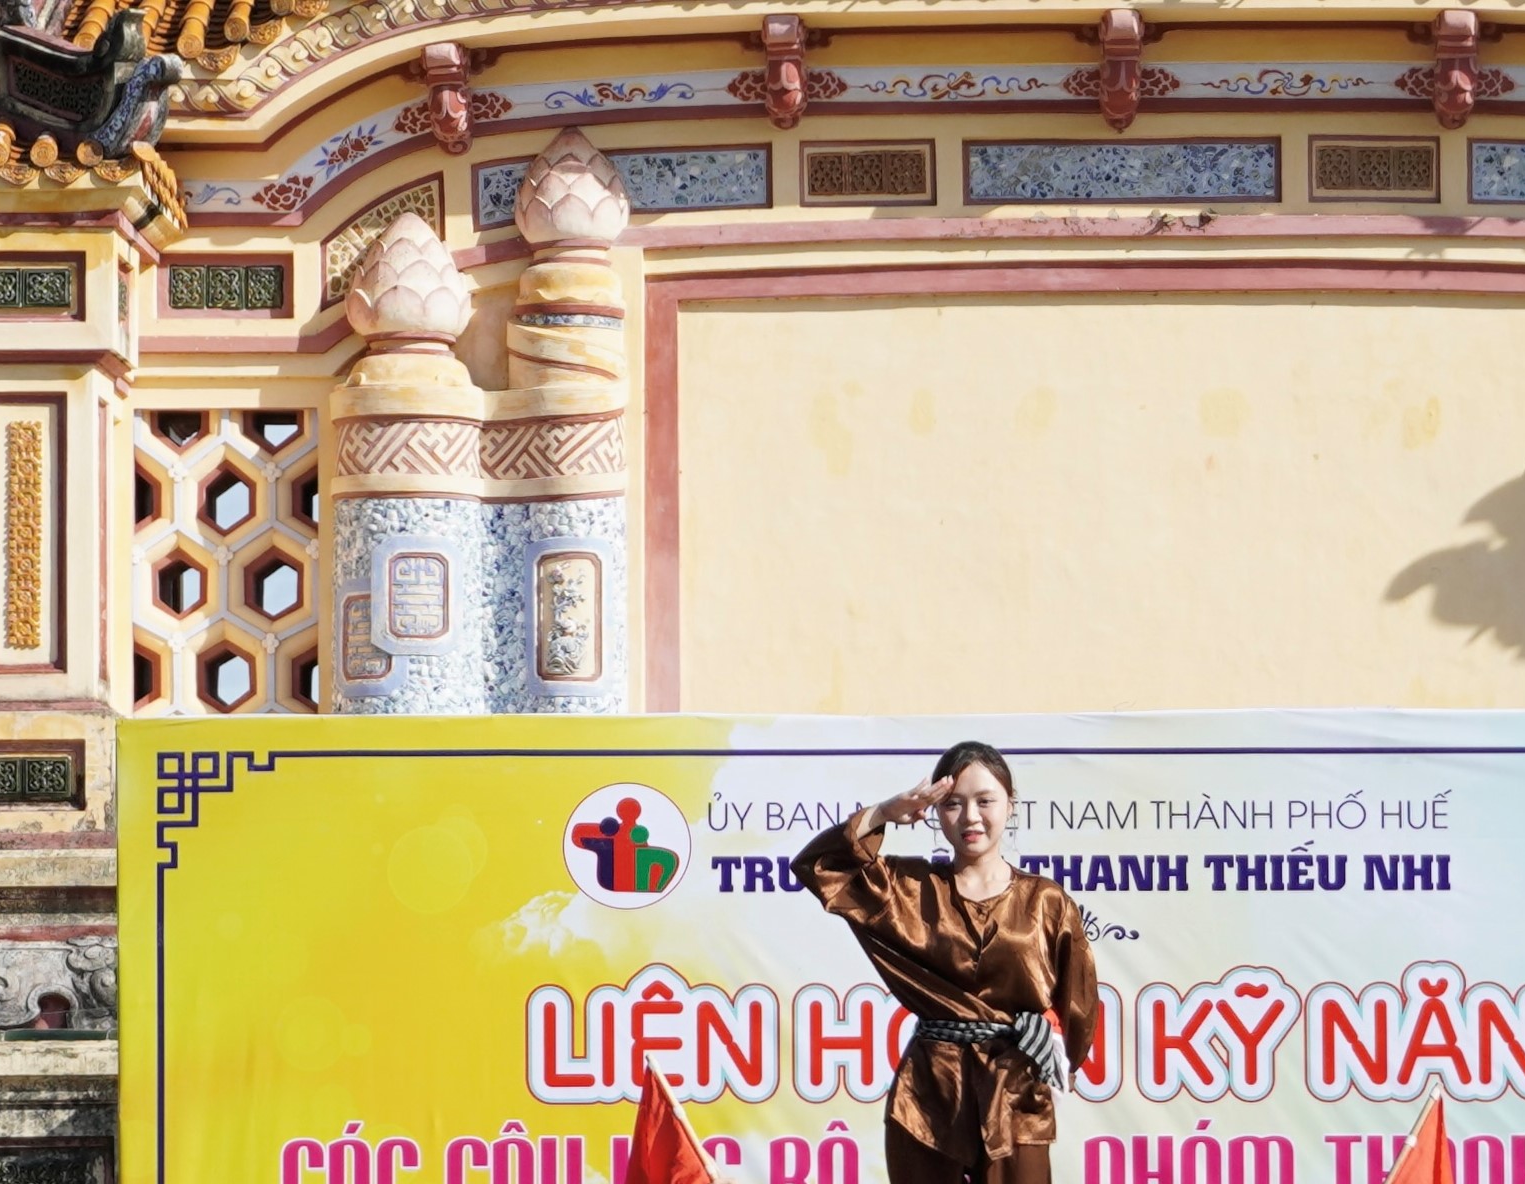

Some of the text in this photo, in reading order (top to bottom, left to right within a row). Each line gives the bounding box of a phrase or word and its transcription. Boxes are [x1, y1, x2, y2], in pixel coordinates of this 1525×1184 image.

[706, 791, 753, 832] ỦY
[765, 801, 841, 832] BAN
[1049, 800, 1139, 831] NAM
[1150, 793, 1274, 831] THÀNH
[1288, 788, 1367, 832] PHỐ
[1381, 788, 1453, 831] HUẾ
[710, 839, 1452, 893] TRU THANH THIẾU NHI
[539, 976, 767, 1091] LIÊN
[1150, 980, 1287, 1088] KỸ
